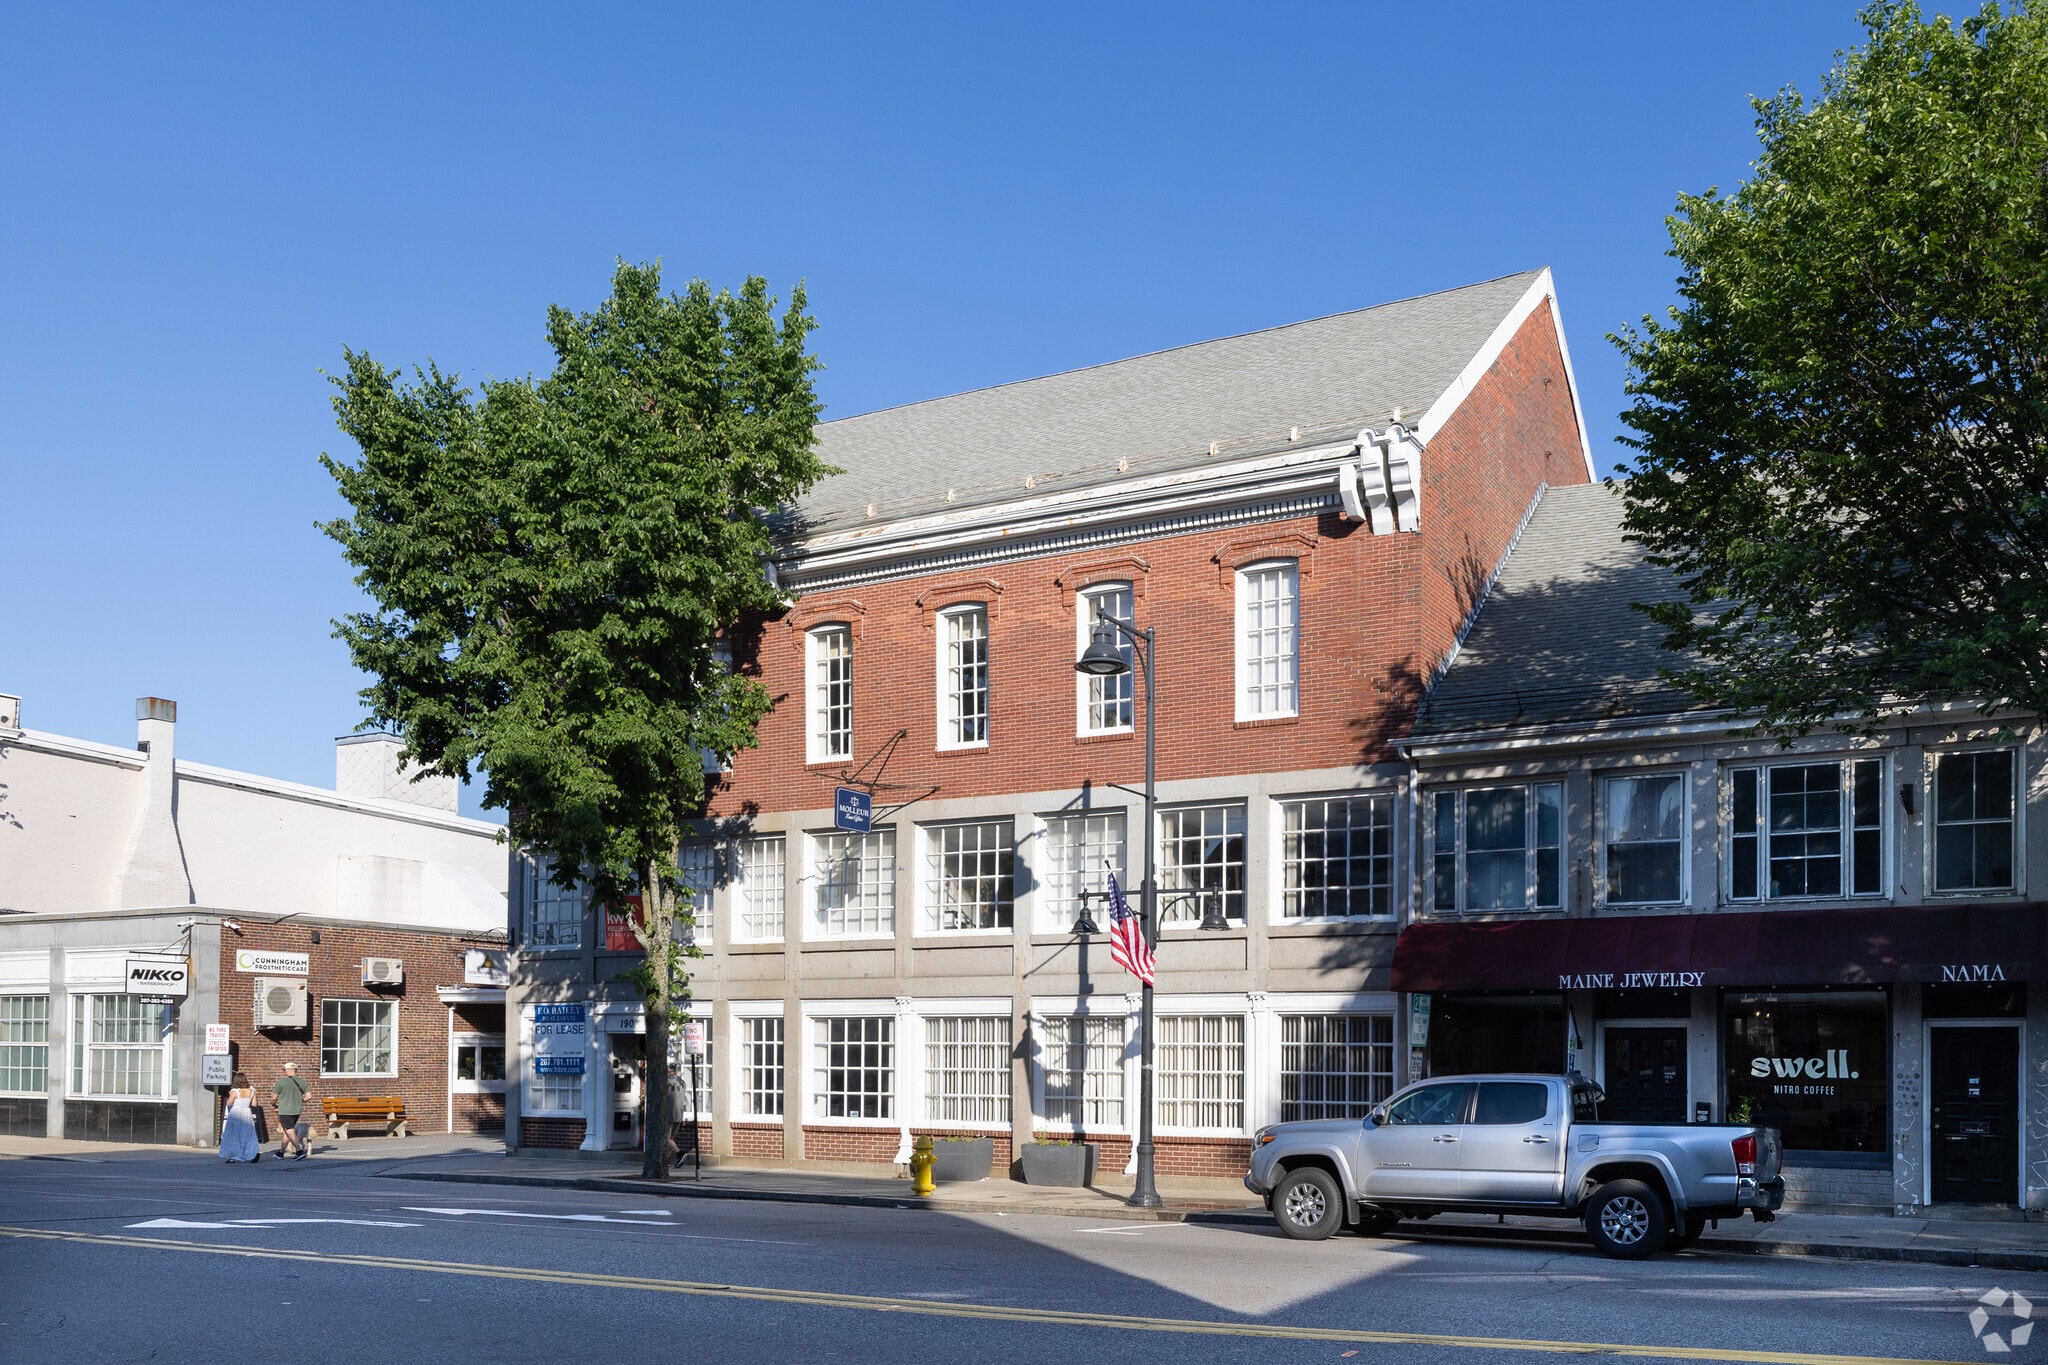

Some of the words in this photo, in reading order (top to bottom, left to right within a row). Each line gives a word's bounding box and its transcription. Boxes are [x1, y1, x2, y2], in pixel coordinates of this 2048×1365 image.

[839, 805, 869, 817] MOLLEUR
[607, 912, 624, 924] kw
[255, 957, 307, 966] CUNNINGHAM
[130, 969, 185, 981] NIKKO
[1942, 964, 2006, 981] NAMA
[1558, 973, 1614, 989] MAINE
[1620, 971, 1706, 988] JEWELRY
[551, 1006, 580, 1015] BAILEY
[620, 1019, 634, 1028] 190
[535, 1025, 553, 1035] FOR
[556, 1025, 584, 1035] LEASE
[540, 1058, 580, 1066] 207.781.1111
[1750, 1049, 1859, 1079] swell.
[1773, 1085, 1800, 1095] NITRO
[1804, 1085, 1835, 1095] COFFEE
